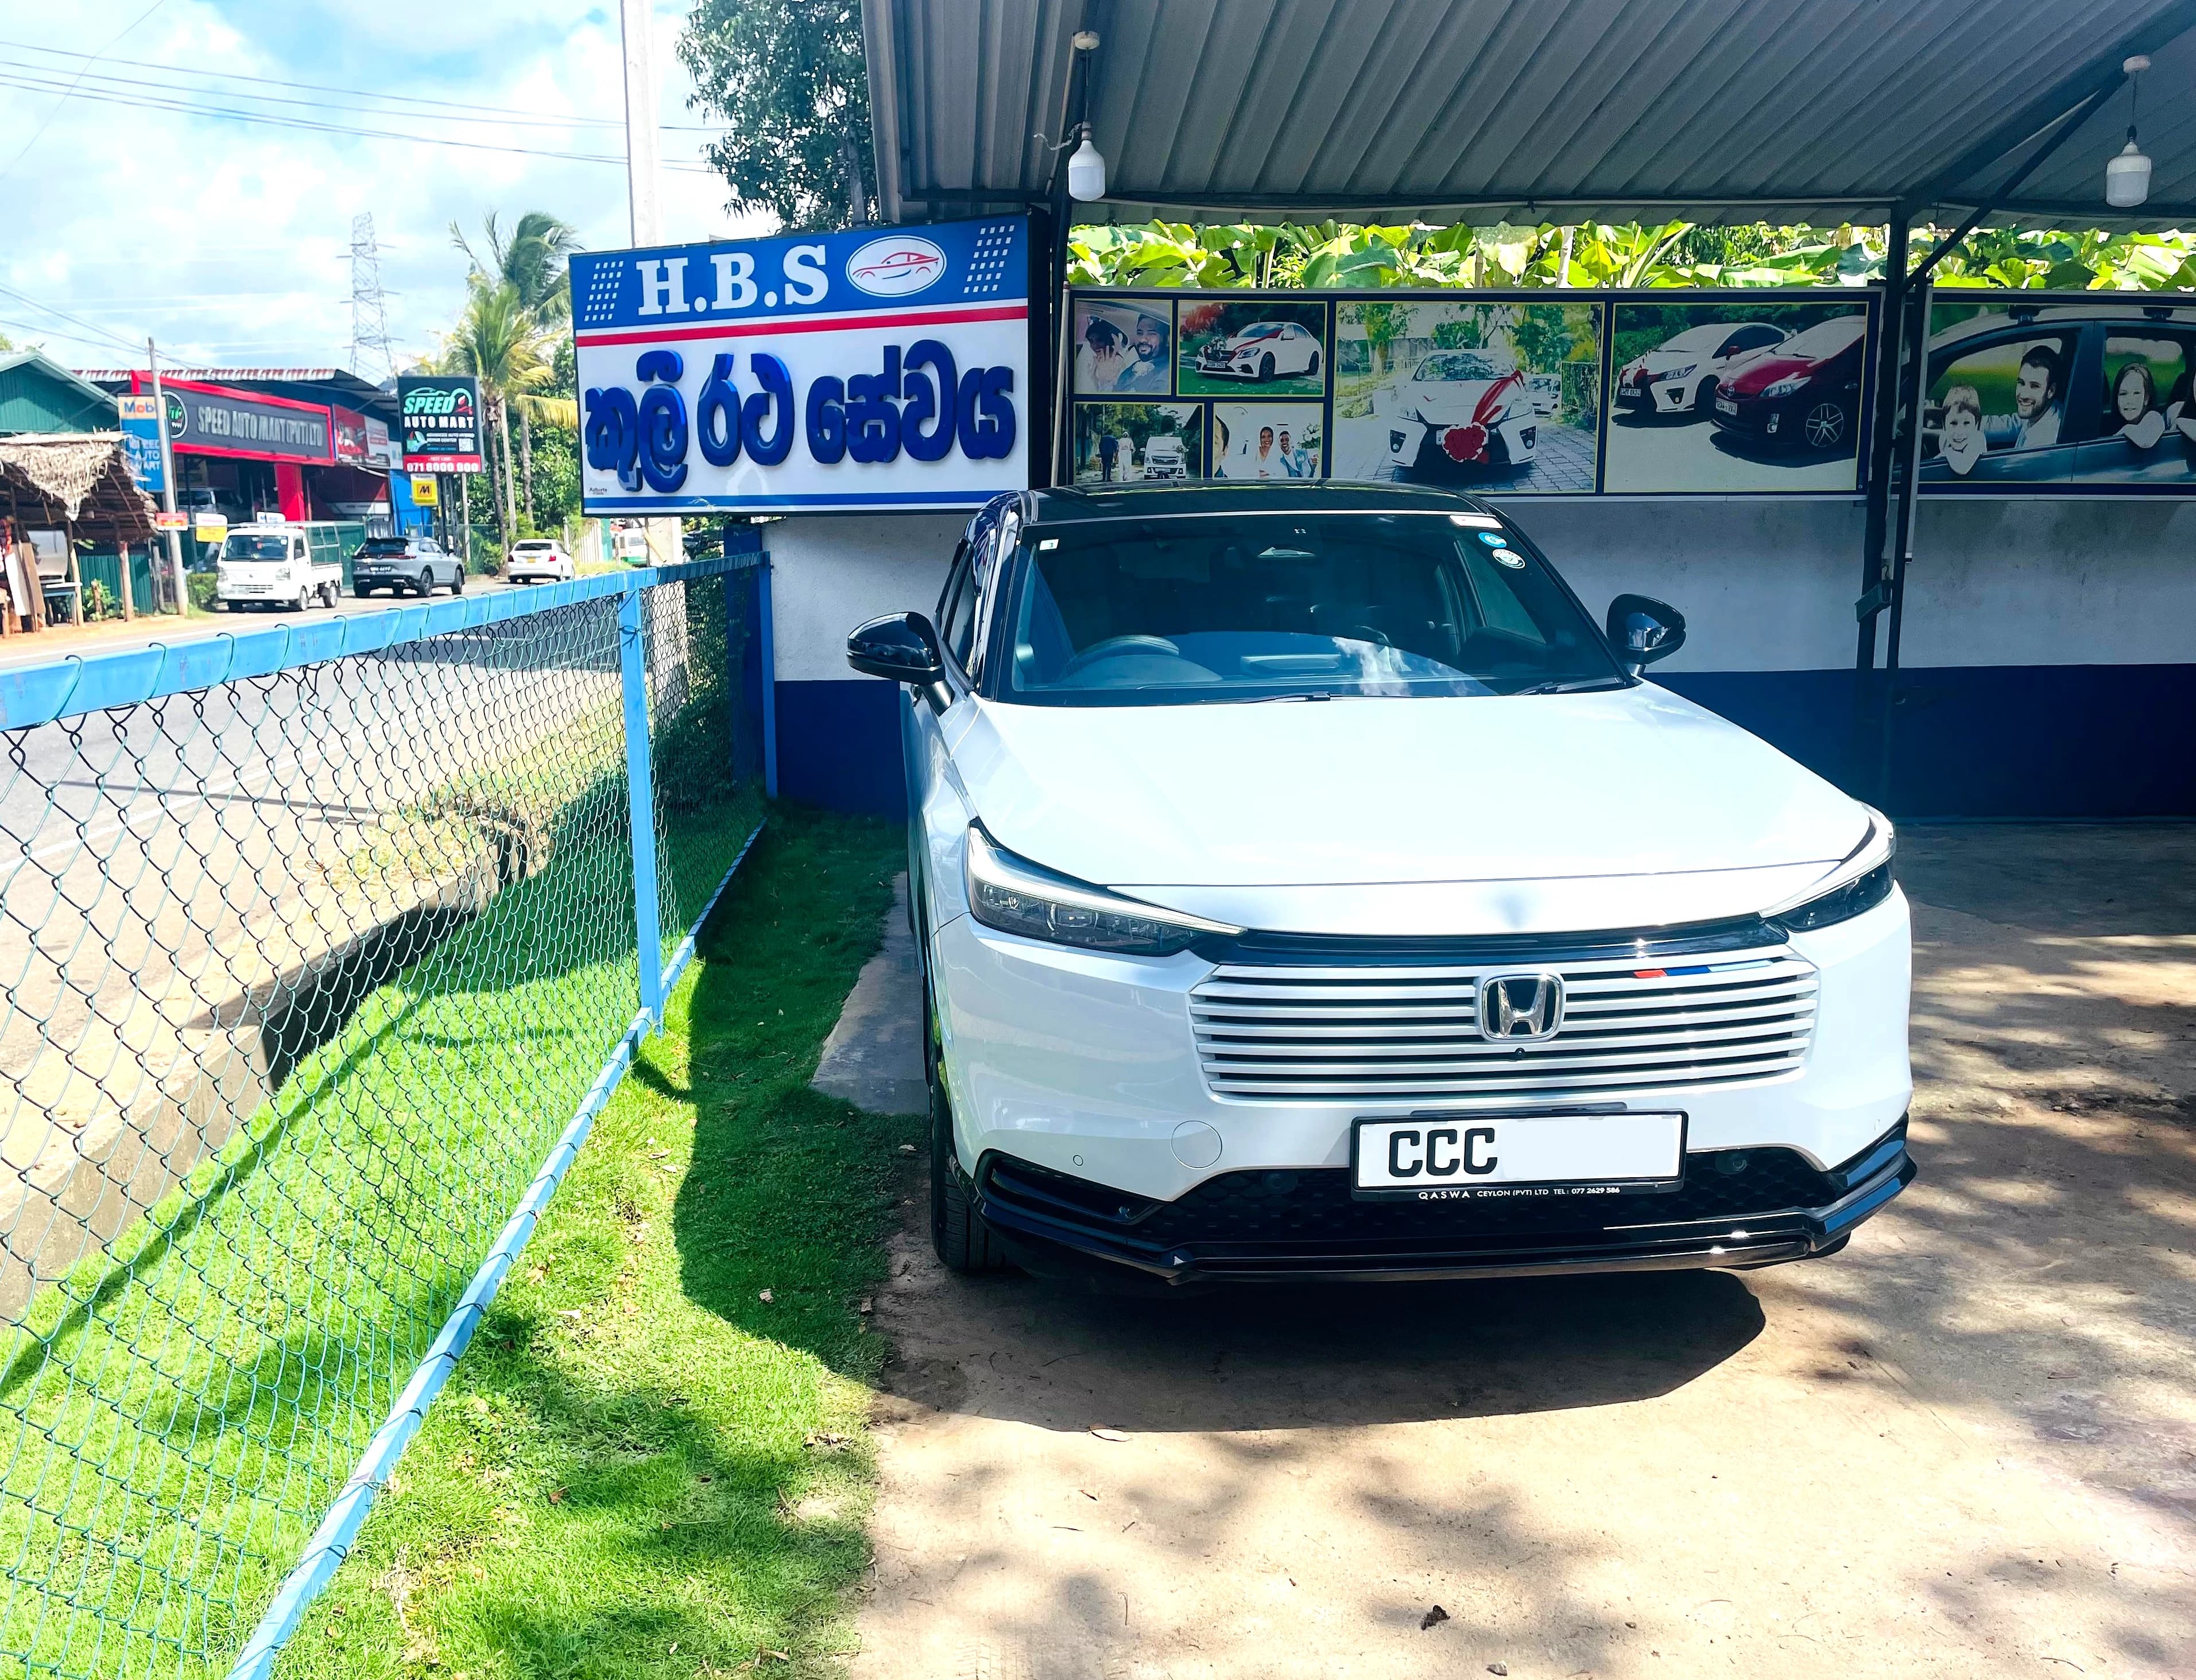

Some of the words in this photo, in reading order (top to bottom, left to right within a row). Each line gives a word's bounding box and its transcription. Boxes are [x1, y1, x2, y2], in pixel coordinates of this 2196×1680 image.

[636, 245, 829, 315] H.B.S
[124, 402, 154, 413] Mob
[403, 397, 456, 414] SPEED
[696, 352, 795, 467] රථ
[805, 339, 1016, 465] සේවය
[197, 406, 230, 436] SPEED
[232, 410, 257, 440] AUTO
[258, 415, 286, 443] MART
[404, 416, 436, 428] AUTO
[438, 416, 475, 429] MART
[406, 462, 424, 472] 071
[1388, 1128, 1498, 1177] CCC
[1418, 1190, 1470, 1200] QASWA
